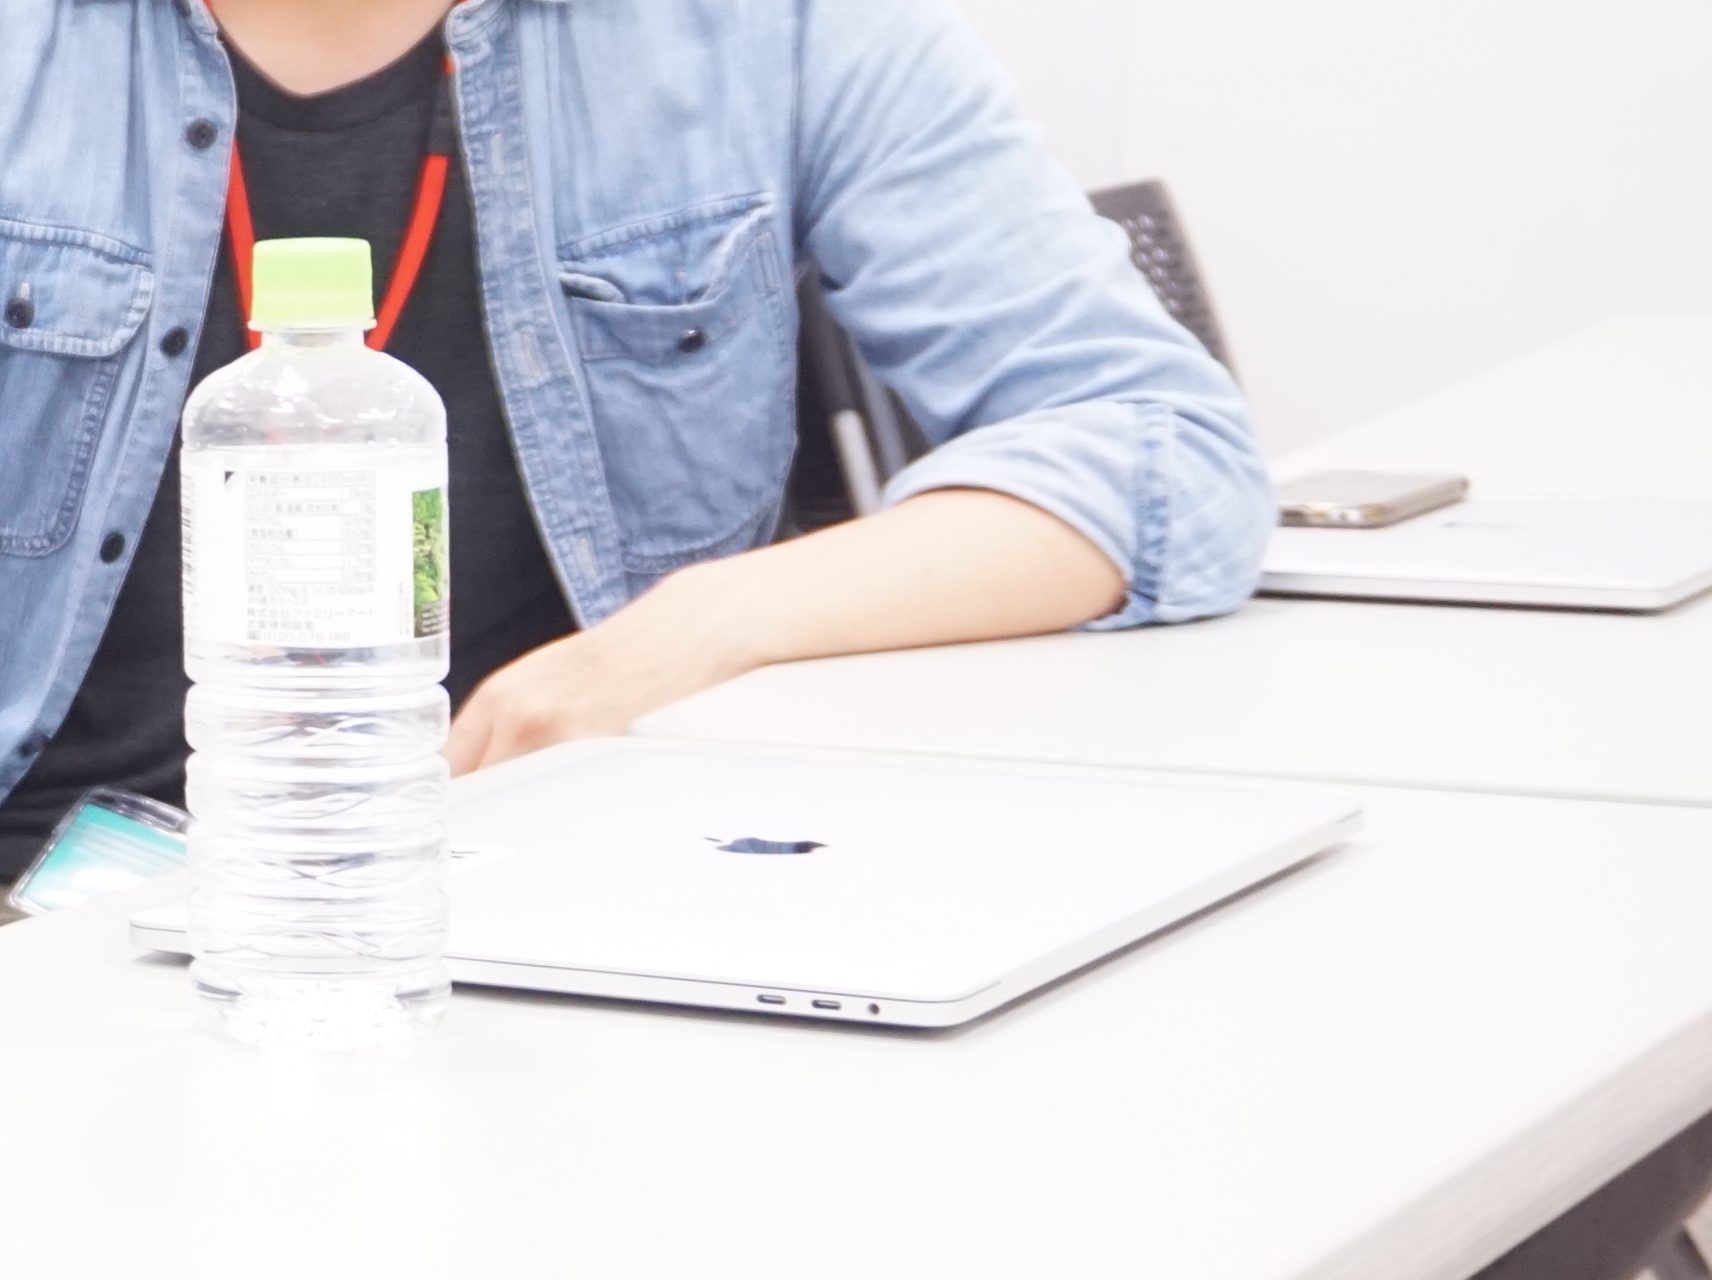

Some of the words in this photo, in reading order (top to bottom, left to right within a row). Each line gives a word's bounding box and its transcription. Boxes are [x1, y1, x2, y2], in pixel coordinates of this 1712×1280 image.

[247, 607, 375, 619] 株式会社ファミリーマート
